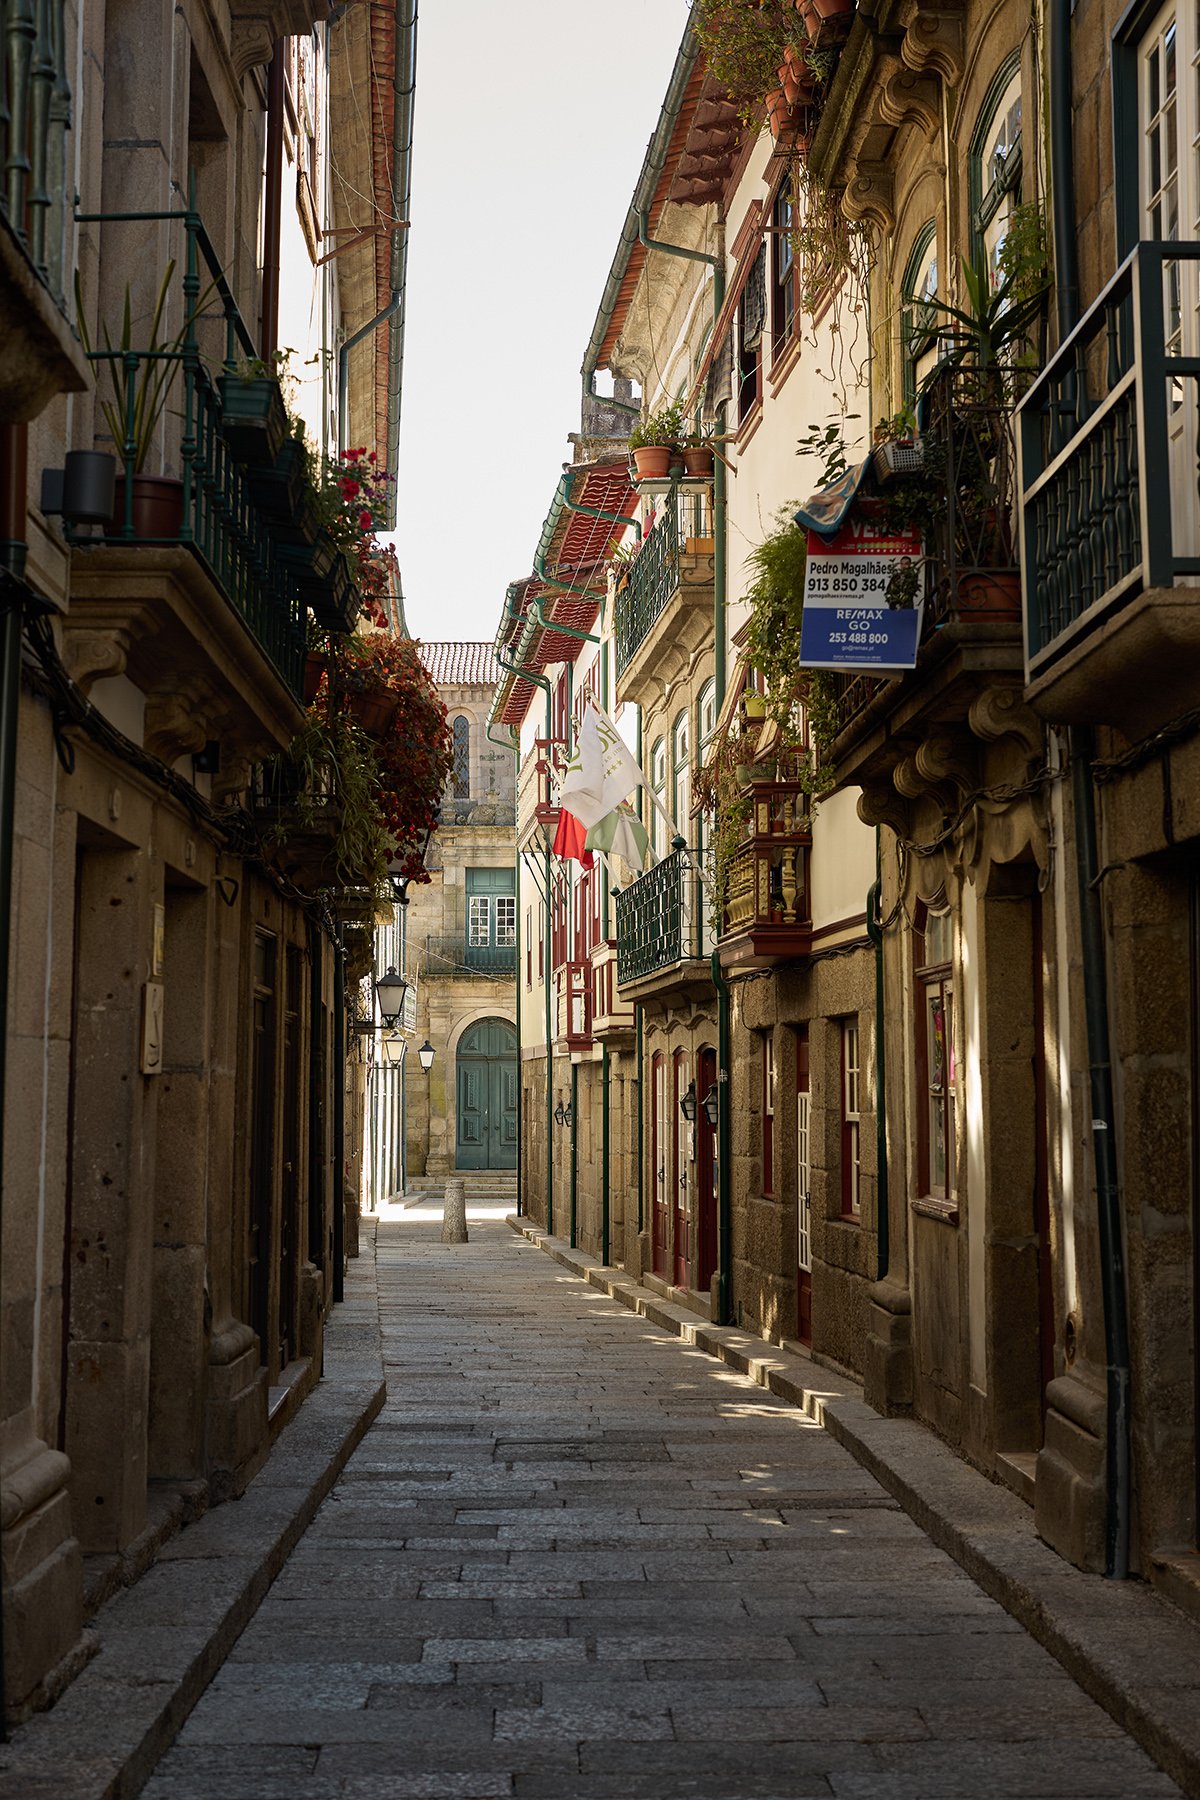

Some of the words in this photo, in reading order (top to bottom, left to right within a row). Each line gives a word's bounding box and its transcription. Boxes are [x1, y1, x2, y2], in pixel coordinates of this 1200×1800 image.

[810, 562, 838, 574] Pedro
[841, 562, 891, 577] Magalhães
[808, 578, 829, 591] 913
[833, 578, 858, 591] 850
[862, 578, 886, 591] 384
[836, 609, 883, 620] RE/MAX
[849, 620, 870, 631] GO
[829, 632, 847, 643] 253
[848, 632, 867, 644] 488
[868, 633, 889, 644] 800
